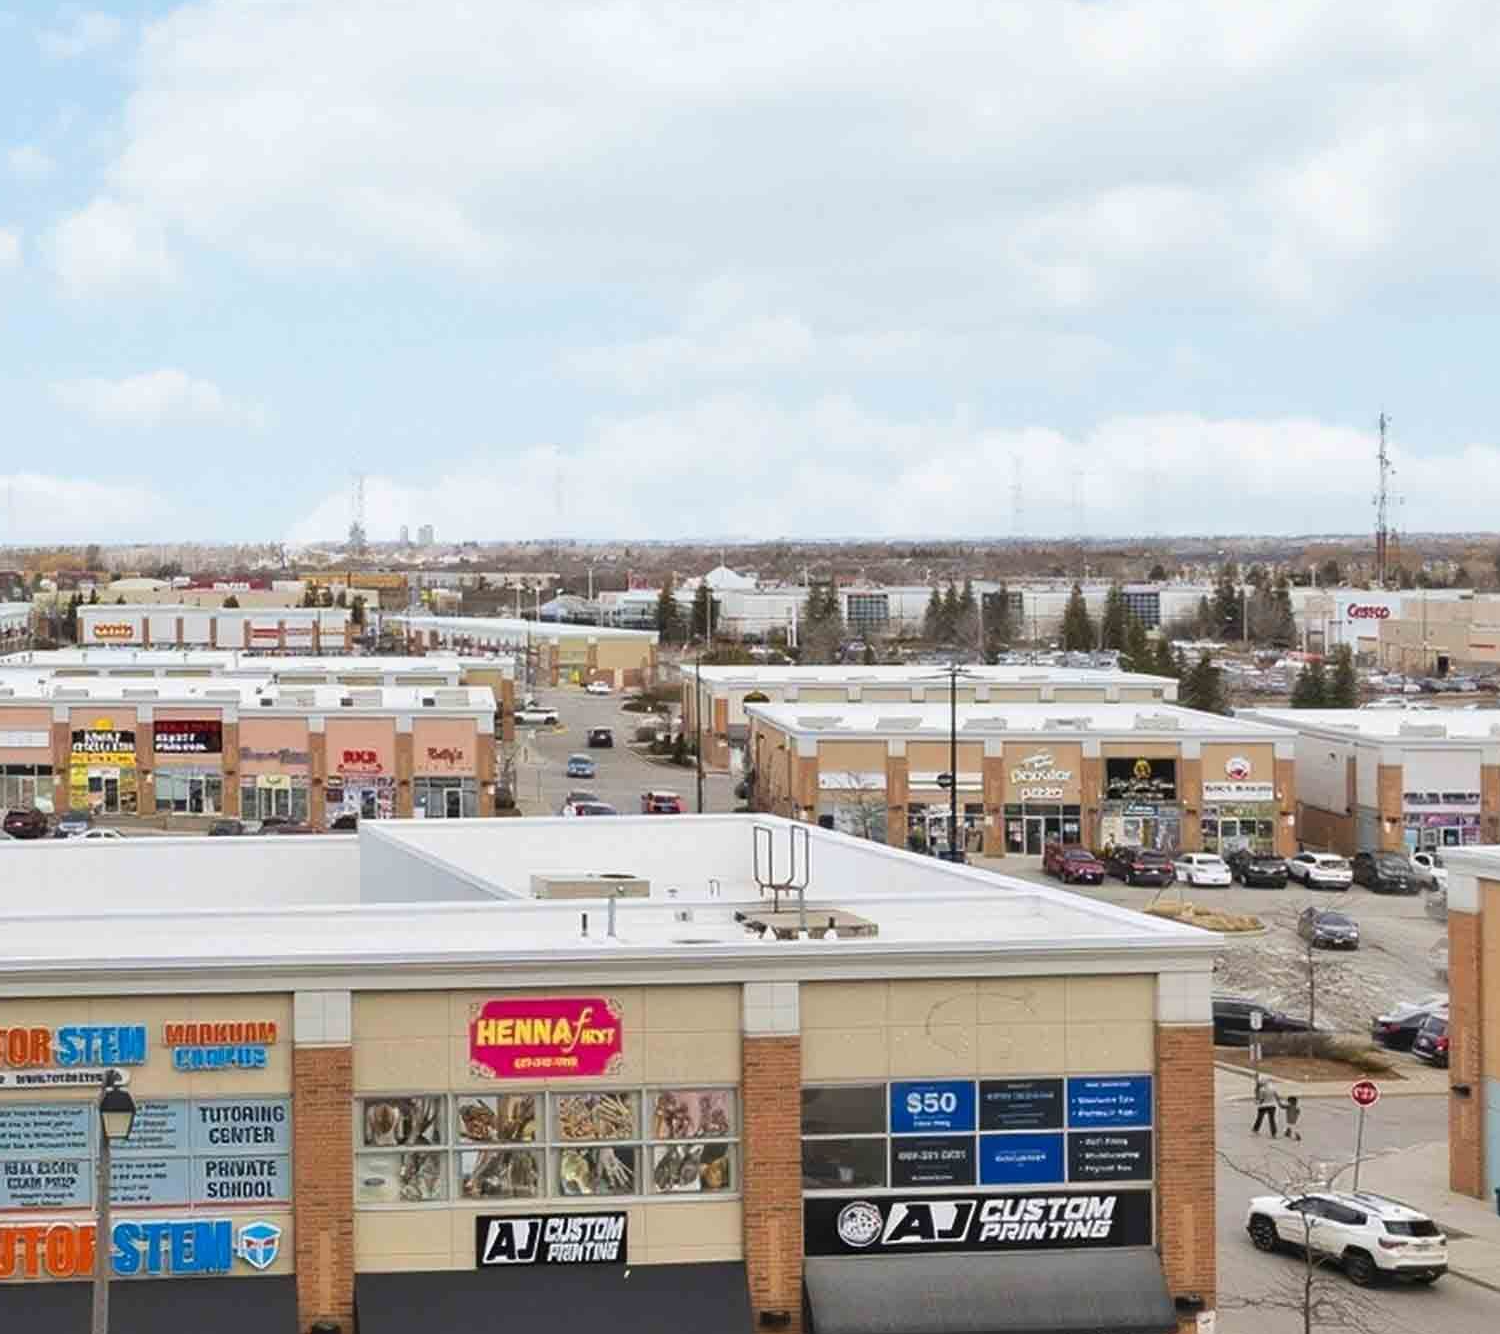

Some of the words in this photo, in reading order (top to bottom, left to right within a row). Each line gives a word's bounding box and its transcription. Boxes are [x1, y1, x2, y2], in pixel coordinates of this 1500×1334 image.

[476, 1018, 572, 1046] HENNA
[56, 1025, 147, 1067] STEM
[199, 1105, 285, 1123] TUTORING
[906, 1092, 957, 1114] $50
[208, 1126, 276, 1144] CENTER
[205, 1159, 278, 1177] PRIVATE
[207, 1181, 274, 1198] SCHOOL
[882, 1199, 977, 1246] AJ
[979, 1196, 1118, 1222] CUSTOM
[979, 1219, 1113, 1243] PRINTING
[111, 1219, 233, 1276] STEM
[483, 1219, 543, 1263] AJ
[543, 1216, 625, 1243] CUSTOM
[547, 1240, 620, 1263] PRINTING
